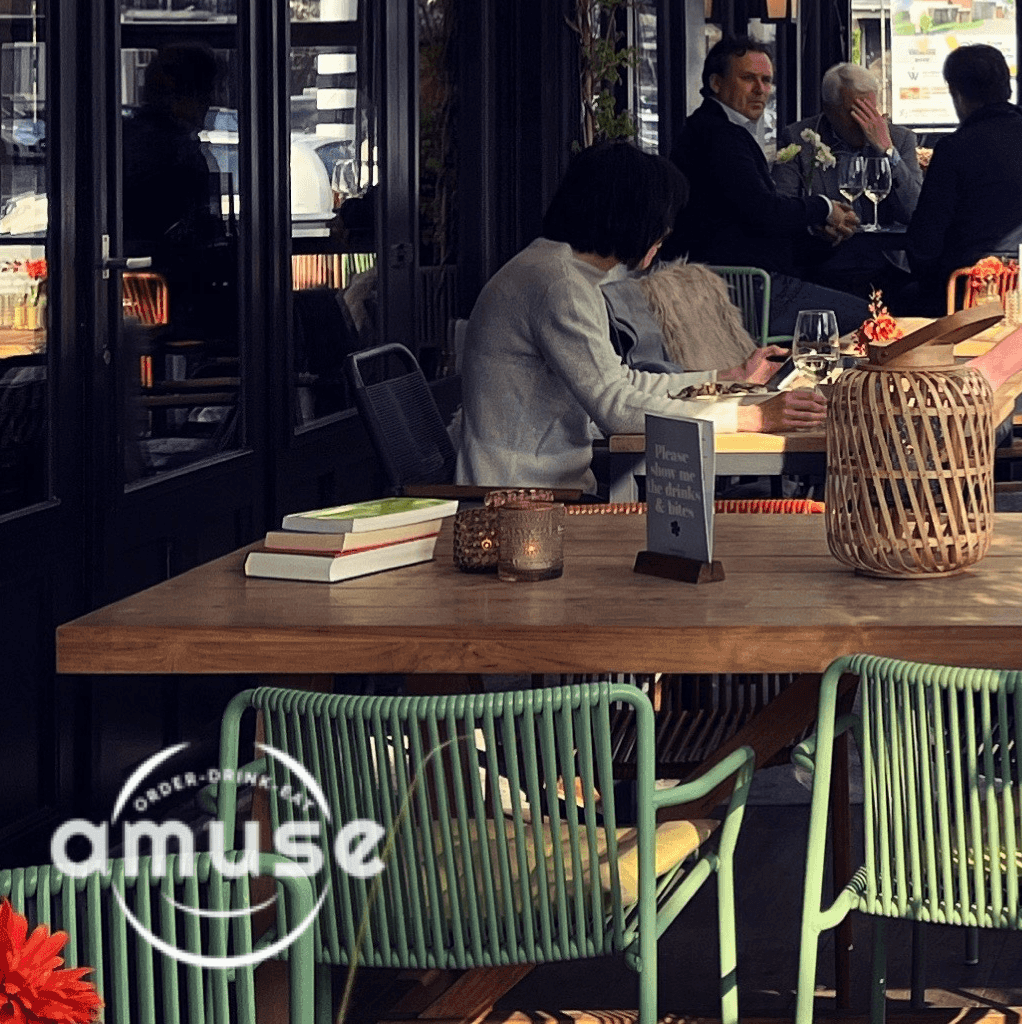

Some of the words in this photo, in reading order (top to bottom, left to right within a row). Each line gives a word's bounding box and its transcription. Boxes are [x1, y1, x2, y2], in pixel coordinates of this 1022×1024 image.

[654, 443, 690, 464] Please
[650, 462, 677, 480] show
[679, 470, 696, 483] me
[647, 478, 664, 495] the
[665, 482, 701, 501] drinks
[654, 497, 666, 514] &
[668, 499, 696, 519] bites
